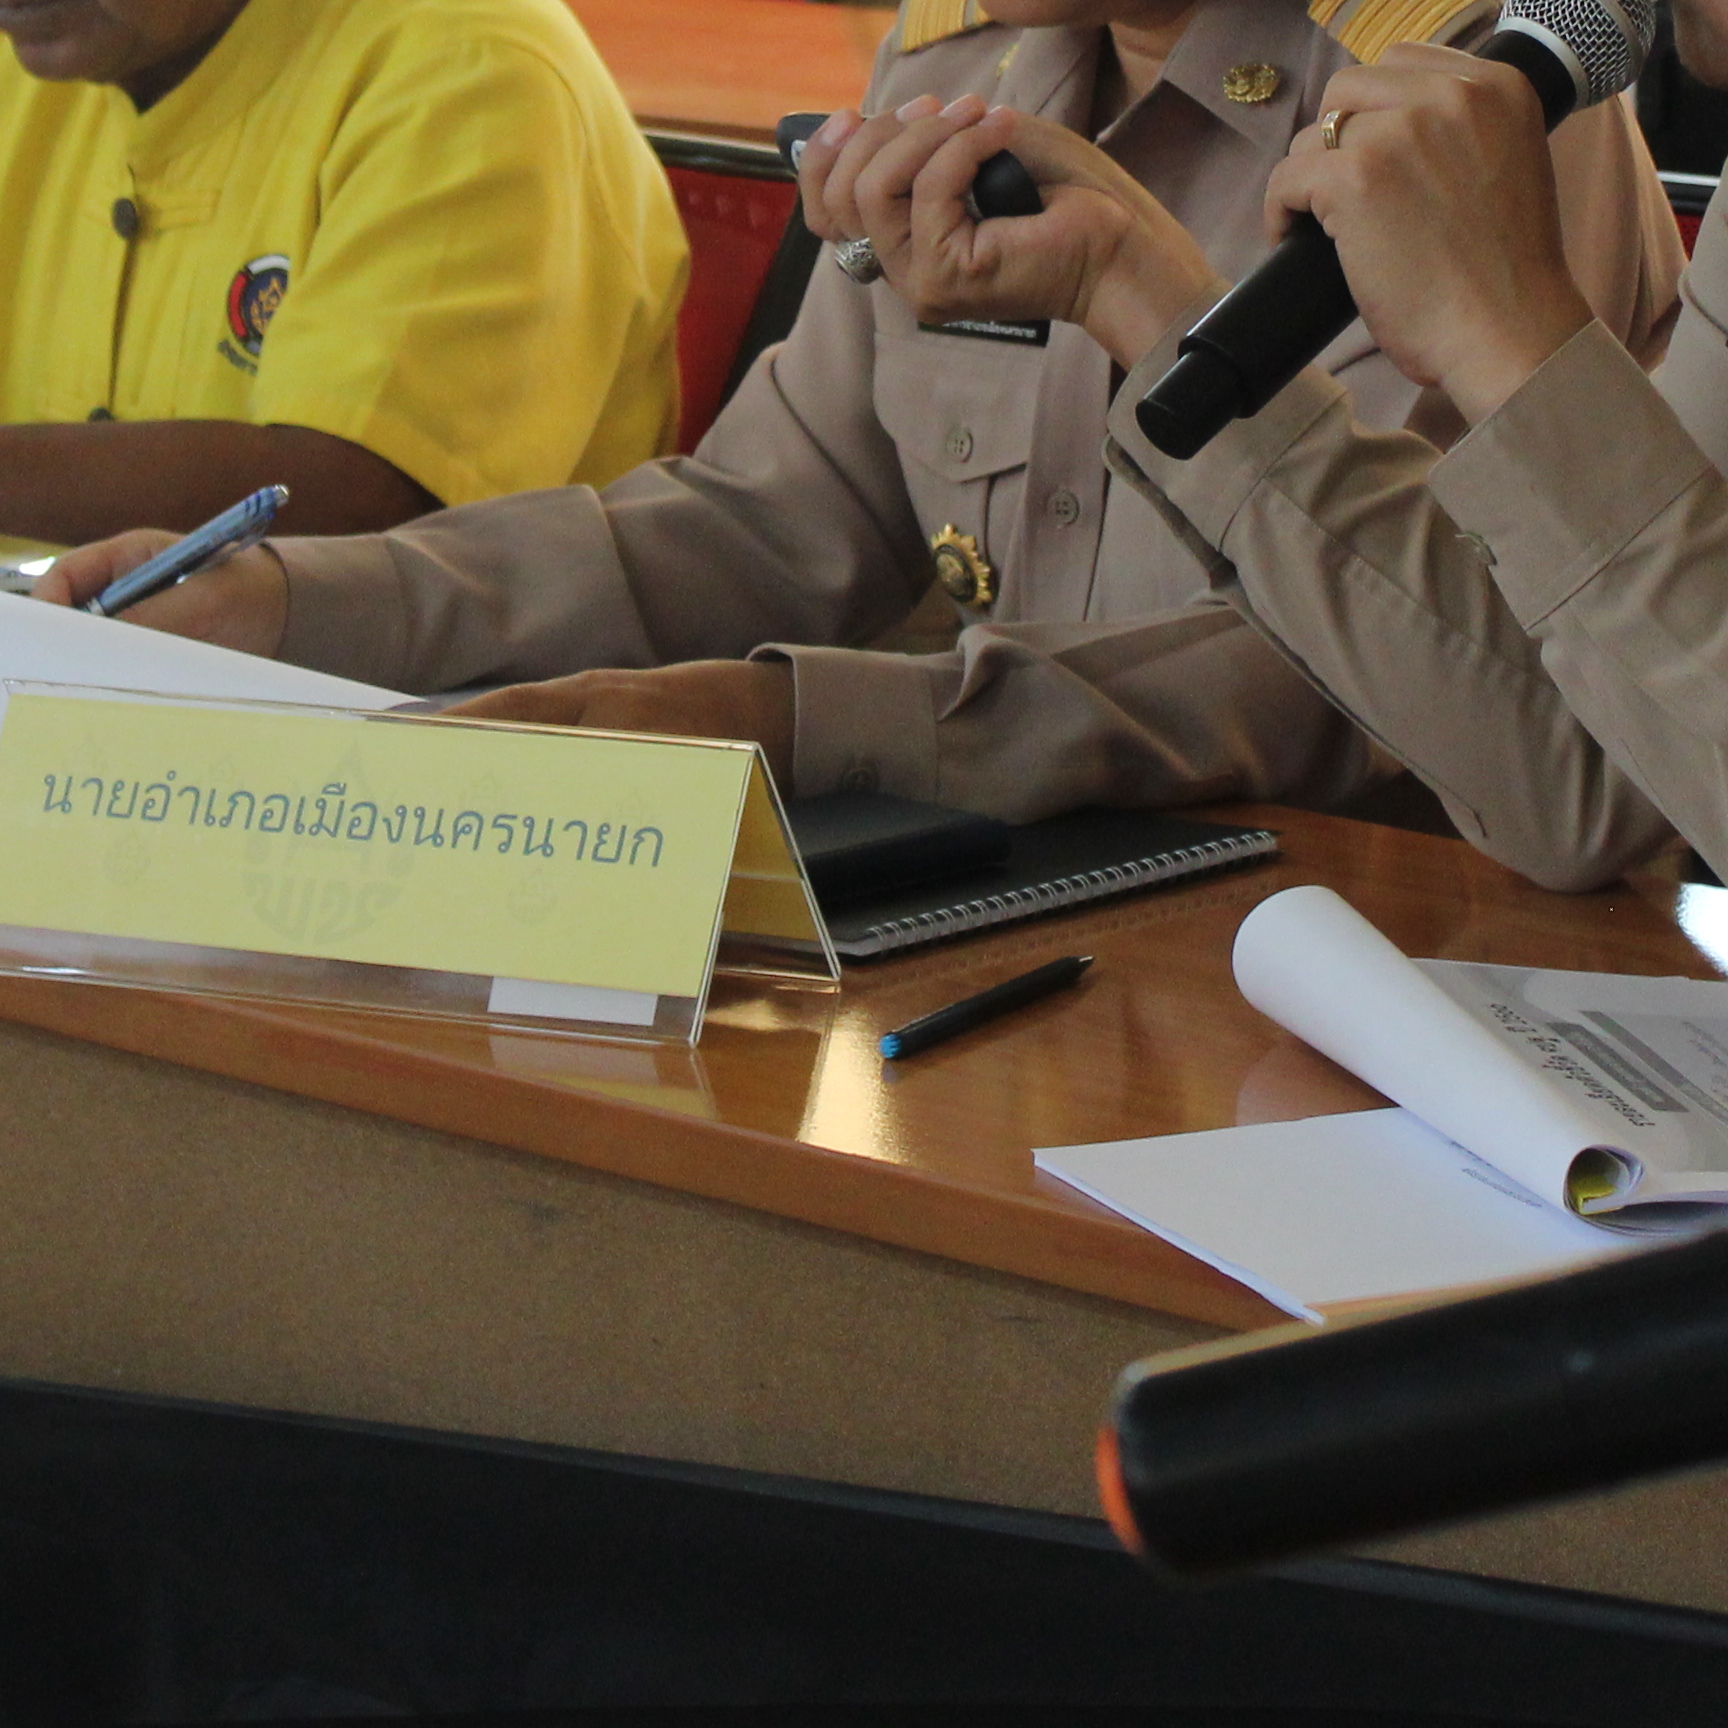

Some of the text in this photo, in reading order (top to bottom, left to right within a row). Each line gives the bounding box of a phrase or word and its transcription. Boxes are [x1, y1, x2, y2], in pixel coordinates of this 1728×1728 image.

[42, 770, 665, 867] นายอำเภอเมืองนครนายก
